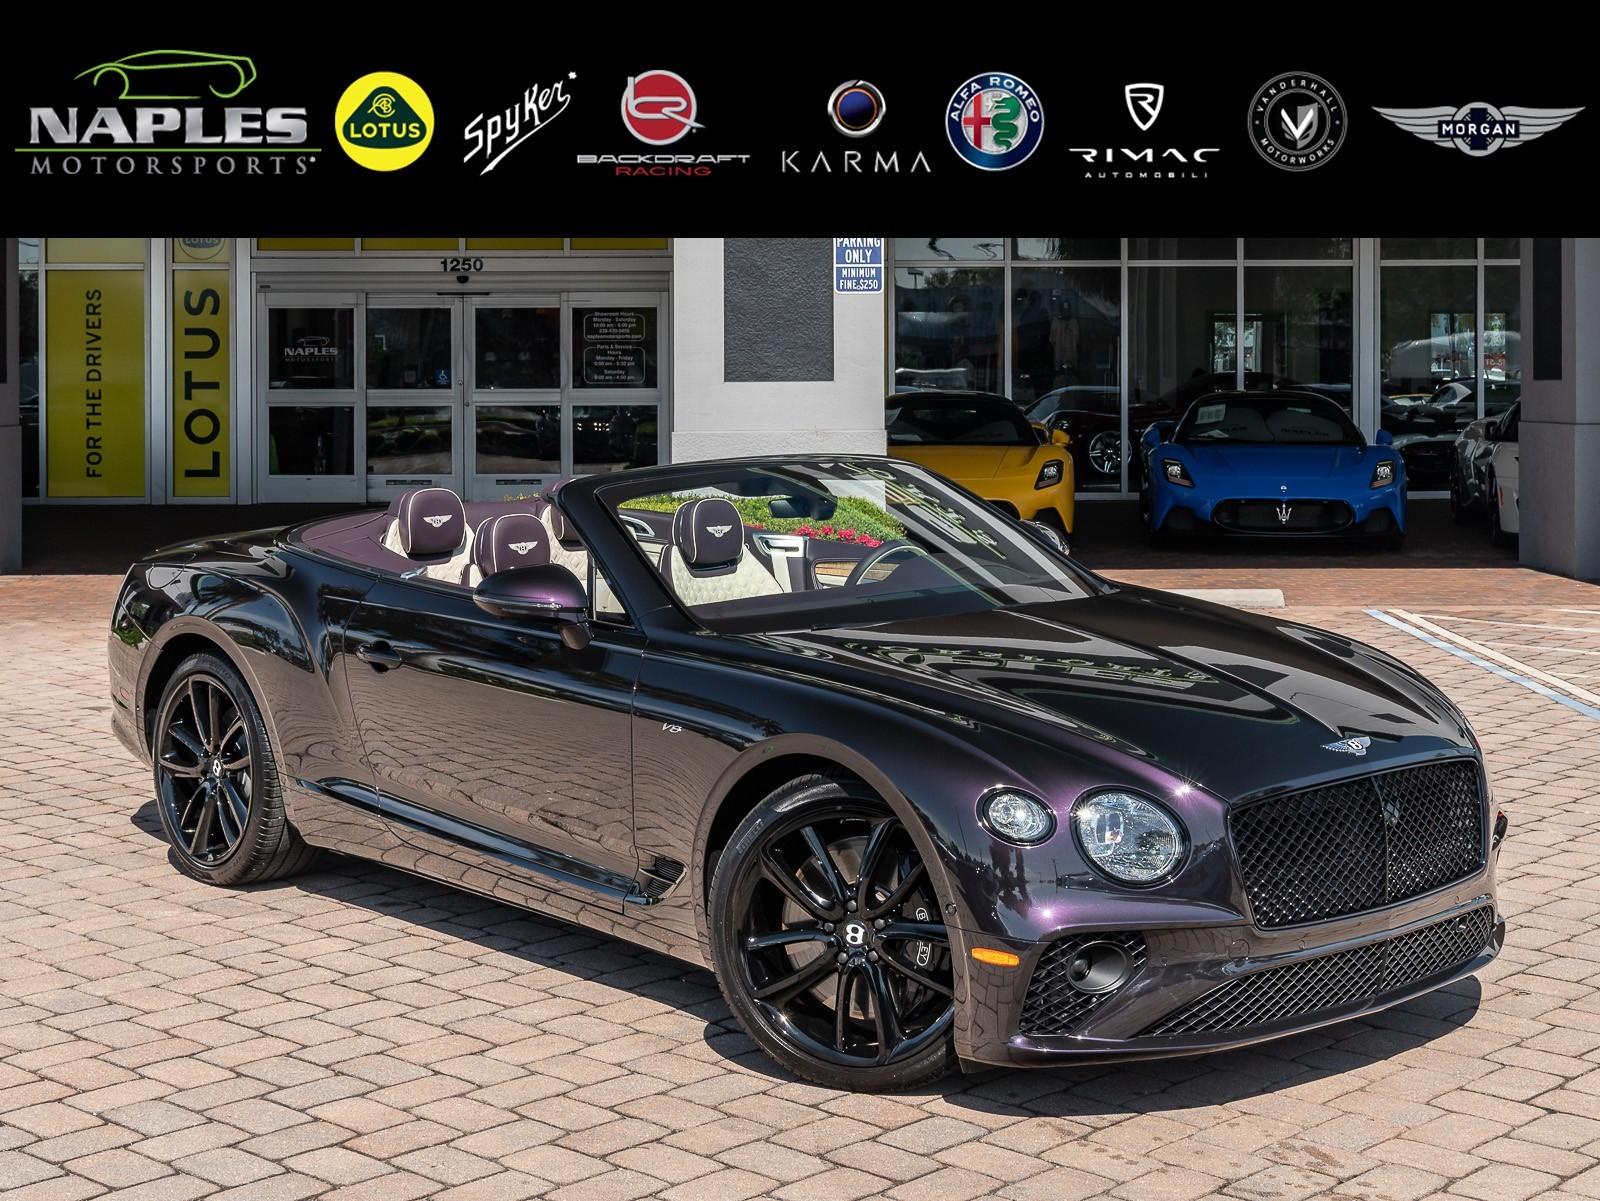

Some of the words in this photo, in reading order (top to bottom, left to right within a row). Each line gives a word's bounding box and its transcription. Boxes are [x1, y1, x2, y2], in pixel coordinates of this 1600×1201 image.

[845, 249, 873, 264] ONLY
[440, 257, 484, 272] 1250
[841, 267, 876, 278] MINIMUM
[86, 289, 102, 382] DRIVERS
[284, 346, 339, 356] NAPLES
[184, 288, 221, 478] LOTUS
[86, 388, 102, 430] THE
[86, 436, 102, 478] FOR
[662, 722, 683, 733] V8
